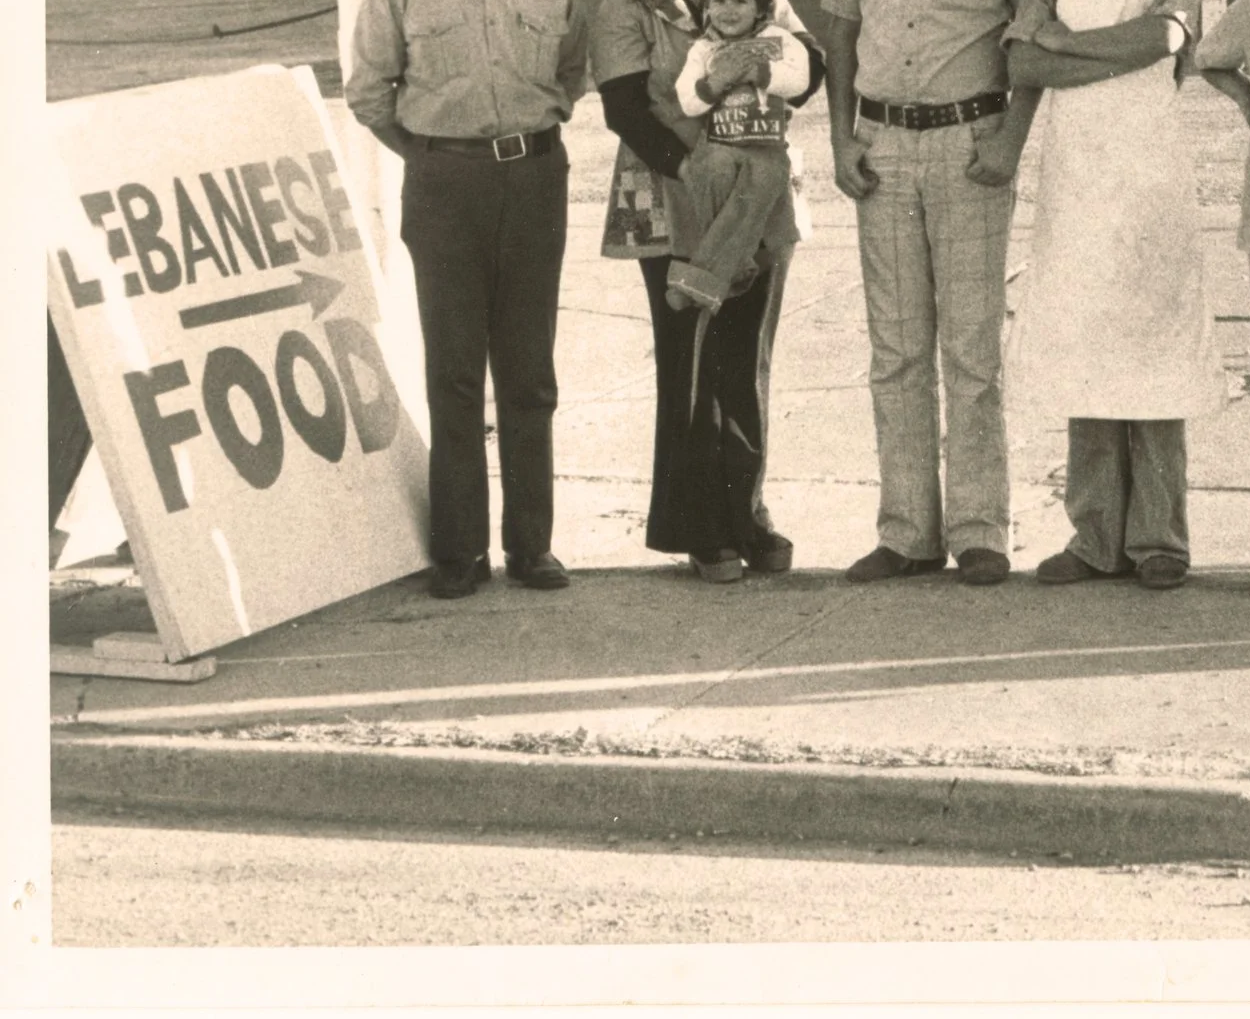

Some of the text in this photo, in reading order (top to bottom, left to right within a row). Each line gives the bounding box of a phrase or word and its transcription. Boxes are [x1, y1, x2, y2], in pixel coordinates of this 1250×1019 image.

[751, 120, 780, 133] EAT
[56, 149, 363, 309] LEBANESE
[123, 316, 401, 514] FOOD
